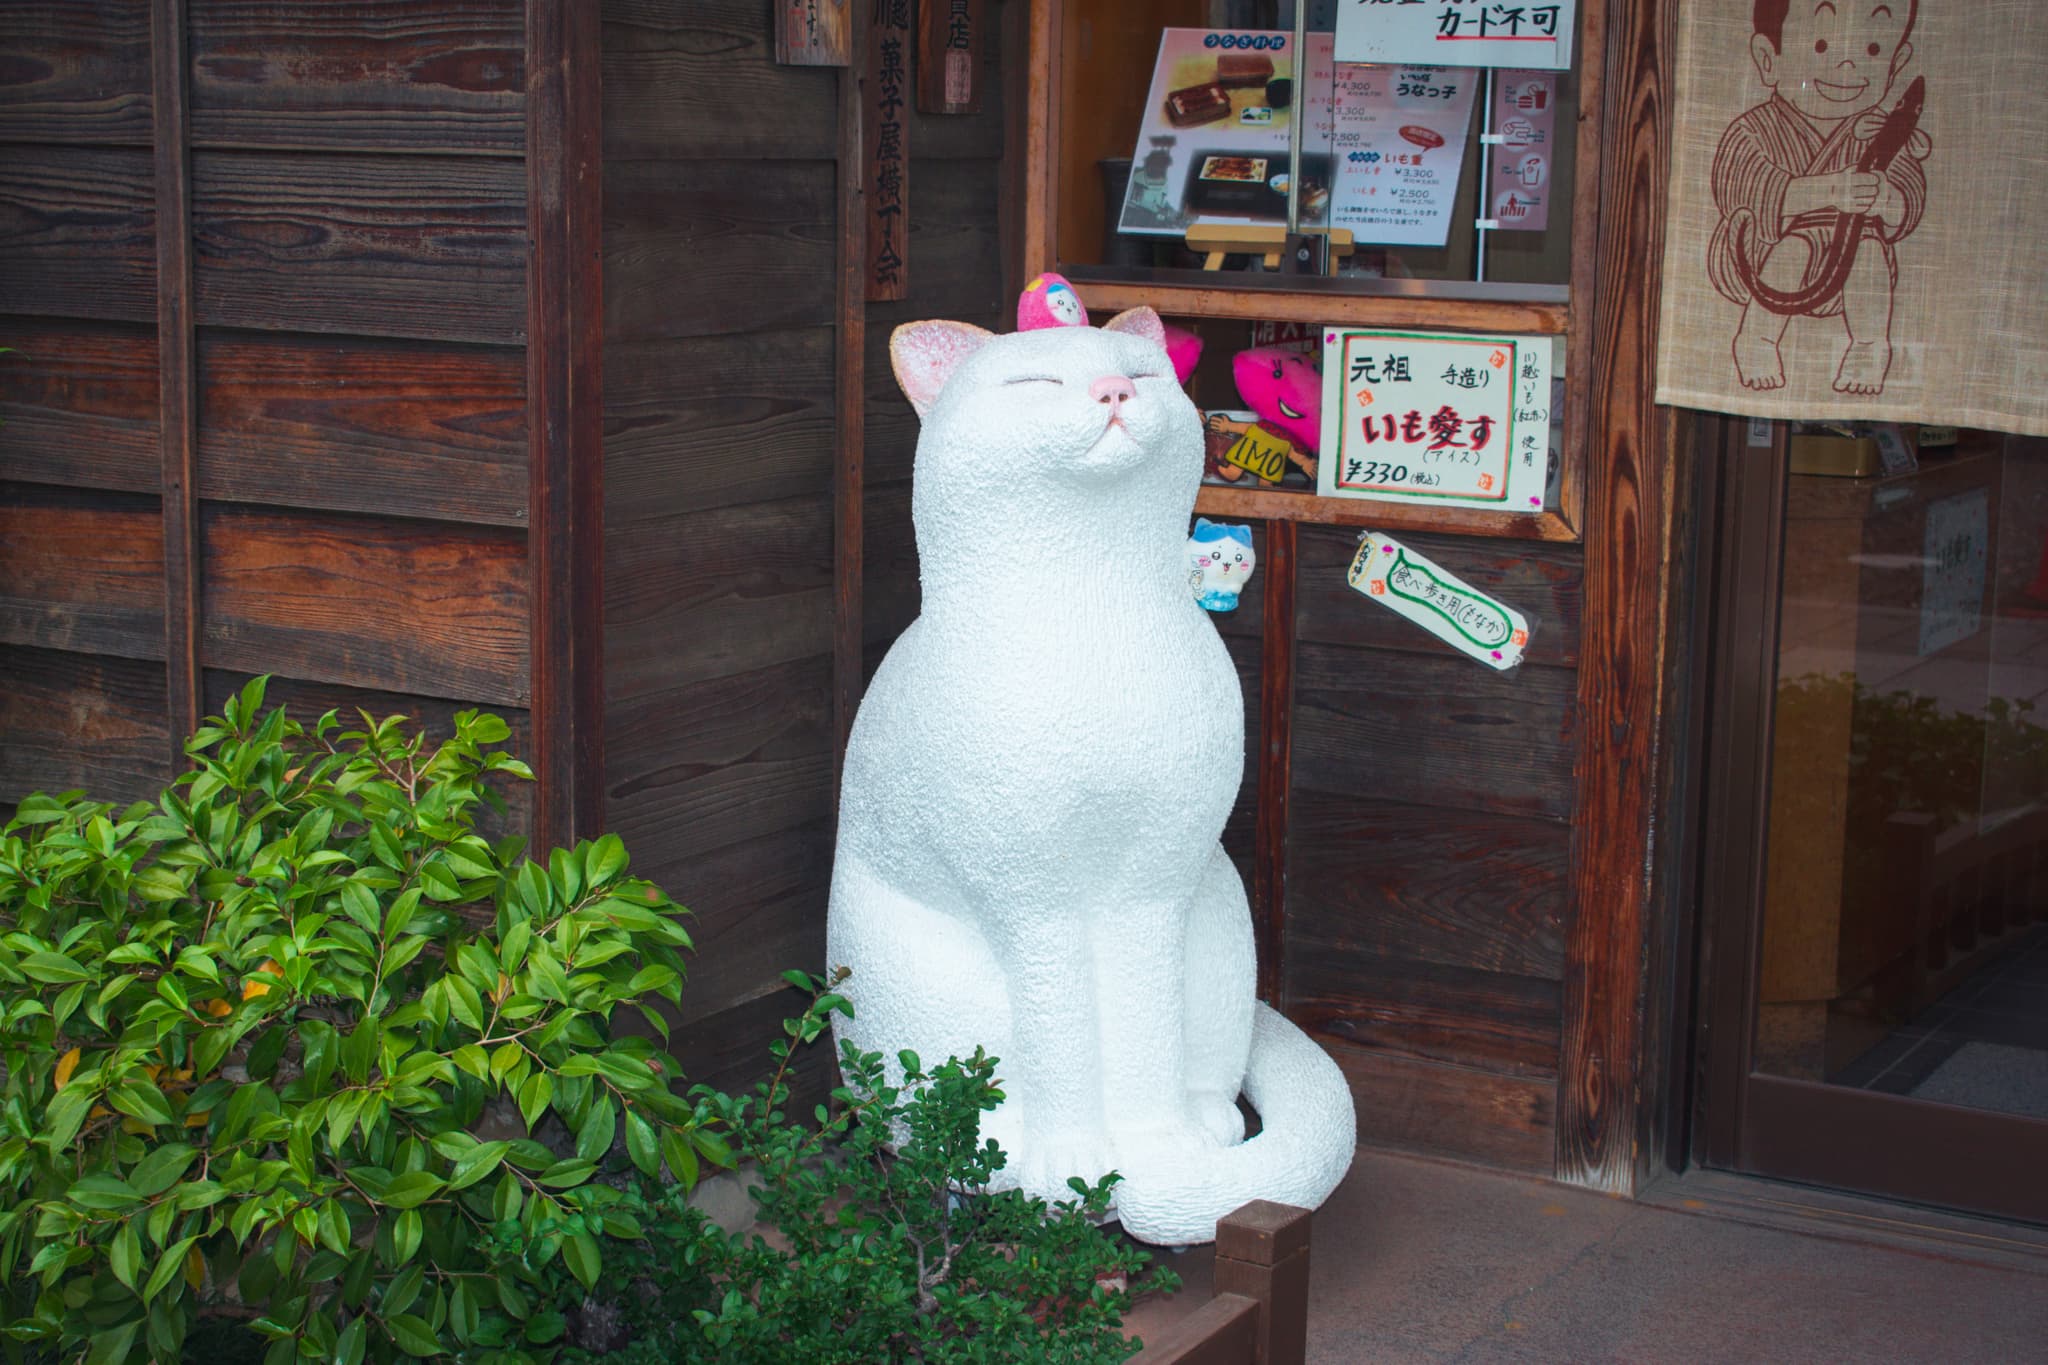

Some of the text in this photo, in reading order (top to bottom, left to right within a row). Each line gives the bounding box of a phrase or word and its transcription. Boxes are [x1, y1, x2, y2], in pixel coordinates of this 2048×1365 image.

[1436, 5, 1560, 37] カード不可
[1397, 84, 1457, 99] うなっ子
[1391, 188, 1430, 199] ¥2,500
[1350, 353, 1490, 389] 元祖 手造り
[1361, 405, 1497, 451] いも愛す
[1235, 437, 1284, 476] IMO
[1345, 458, 1441, 486] ¥330 (税込)
[1422, 450, 1481, 466] (アイス)
[1393, 565, 1506, 642] 食べ歩き用(もなか)
